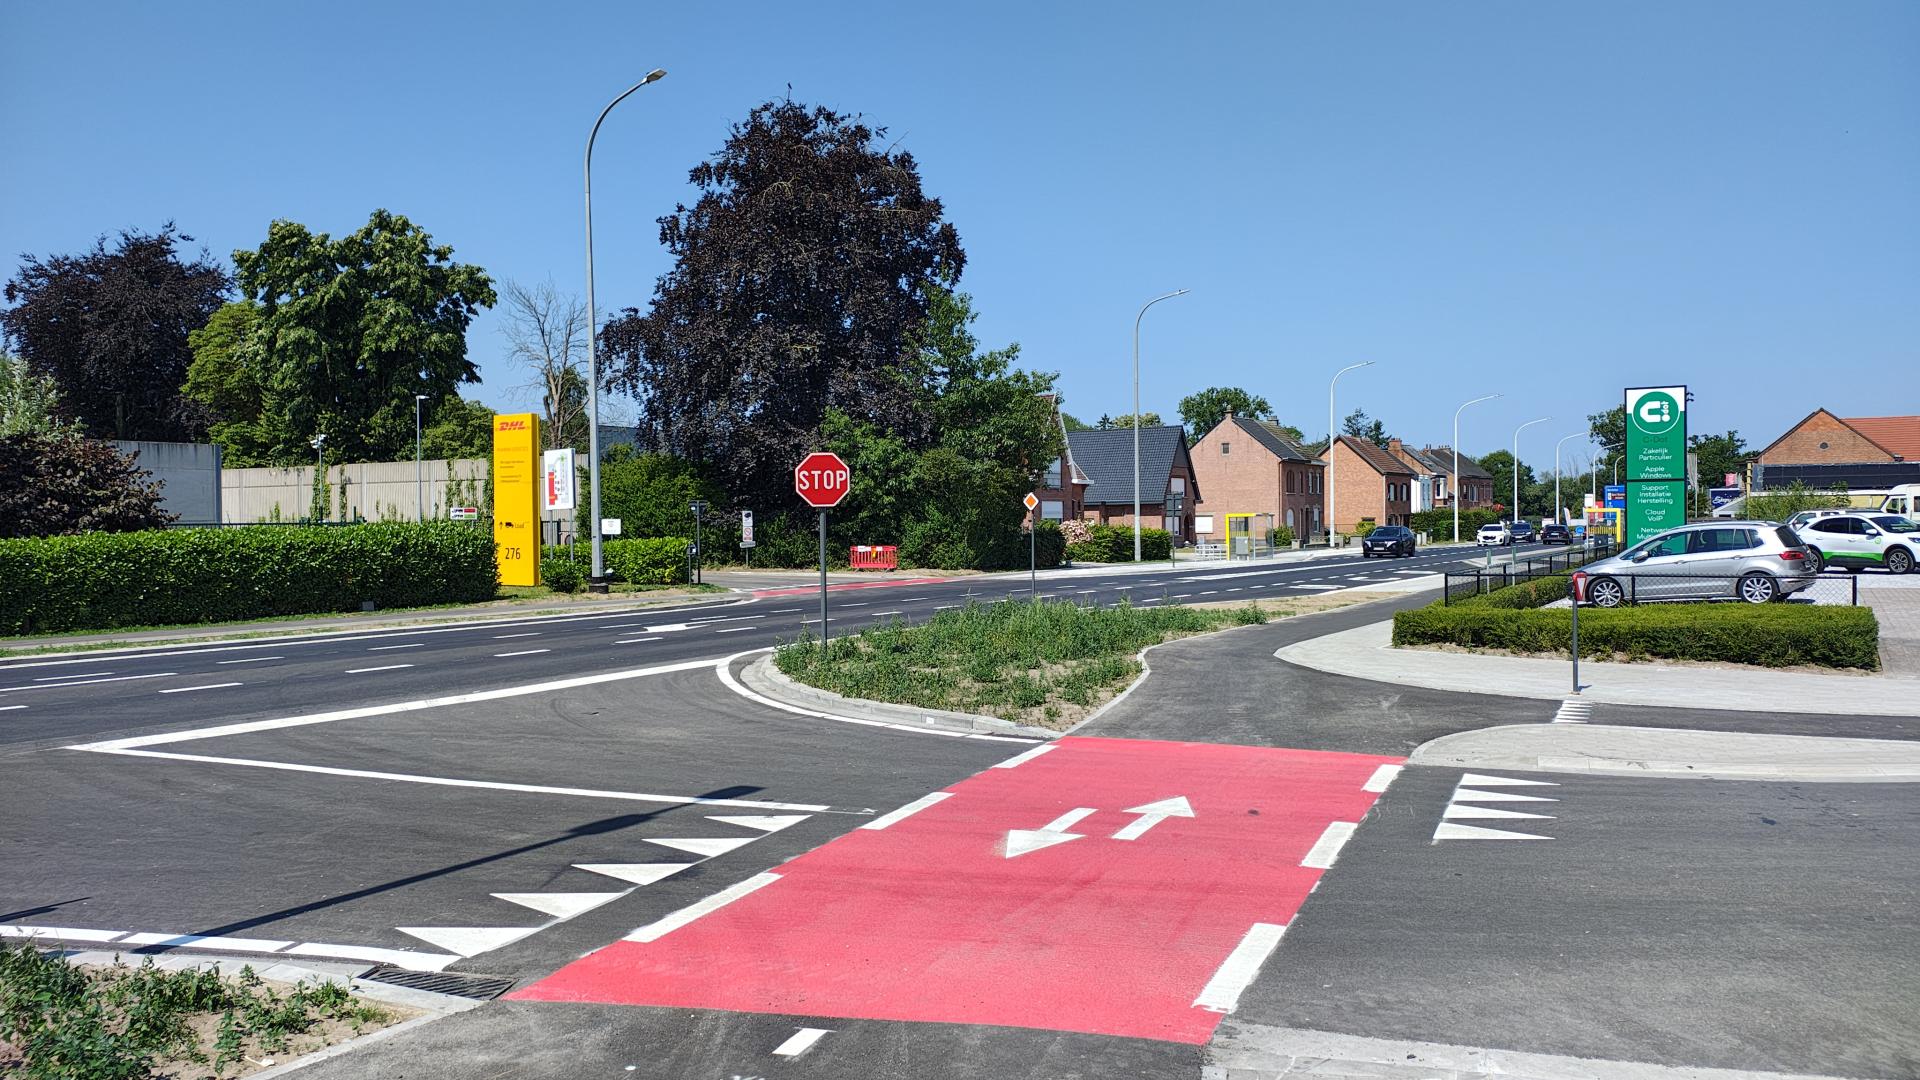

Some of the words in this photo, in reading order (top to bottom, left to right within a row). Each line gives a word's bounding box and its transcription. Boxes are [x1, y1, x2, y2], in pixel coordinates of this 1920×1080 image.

[498, 421, 526, 431] DHL
[799, 470, 846, 490] STOP
[505, 547, 520, 560] 276
